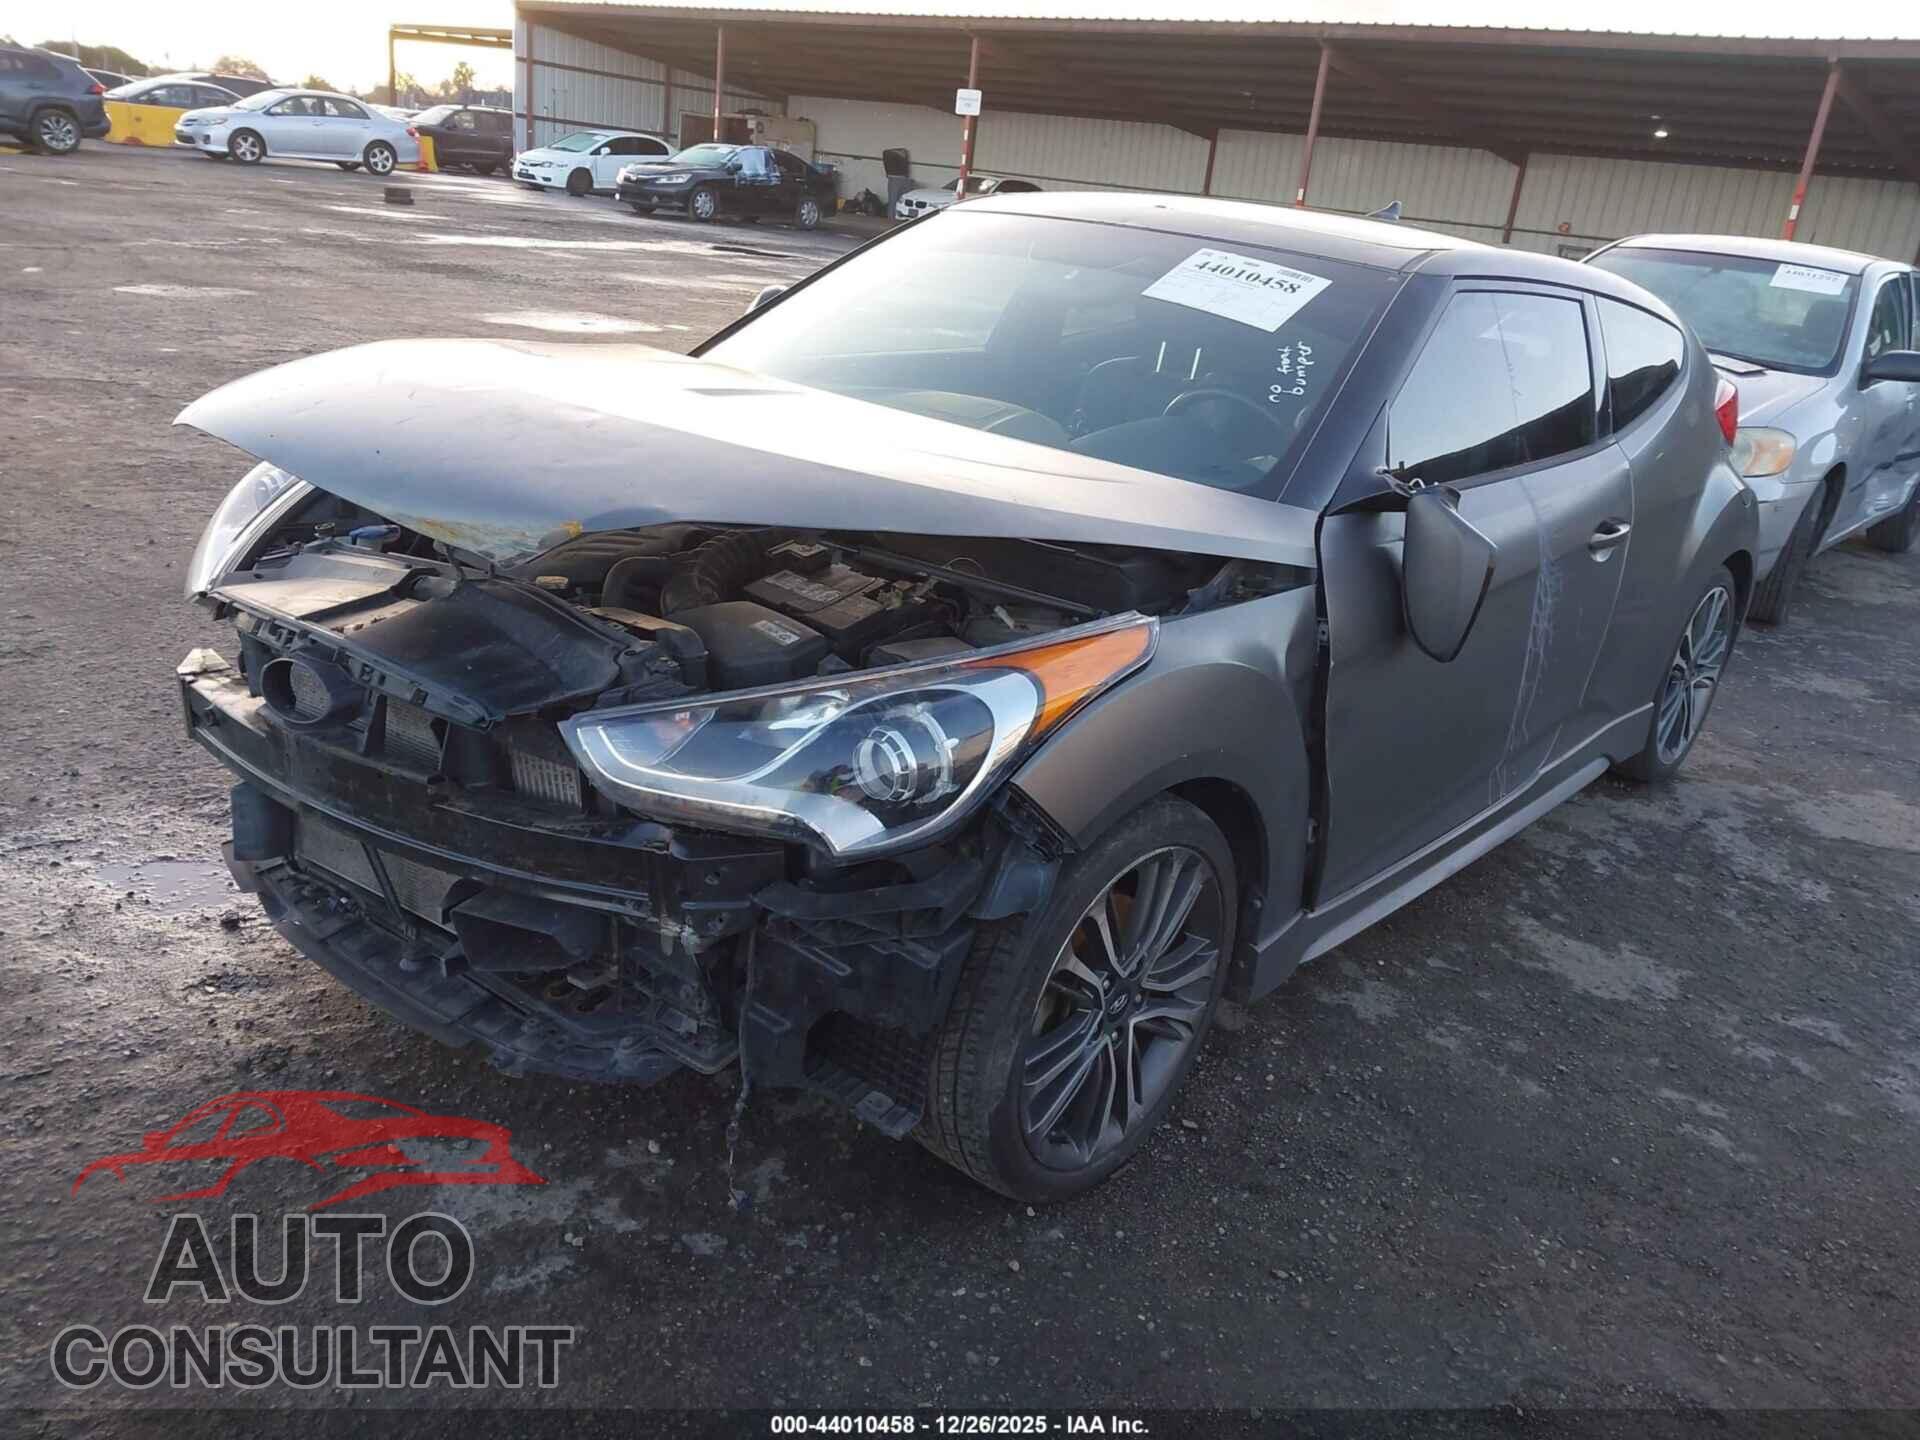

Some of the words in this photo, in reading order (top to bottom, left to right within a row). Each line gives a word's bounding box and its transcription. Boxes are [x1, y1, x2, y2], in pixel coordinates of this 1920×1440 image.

[1194, 261, 1302, 294] 44010458
[1268, 384, 1282, 403] no
[1276, 345, 1295, 375] front
[1282, 341, 1315, 396] bumper
